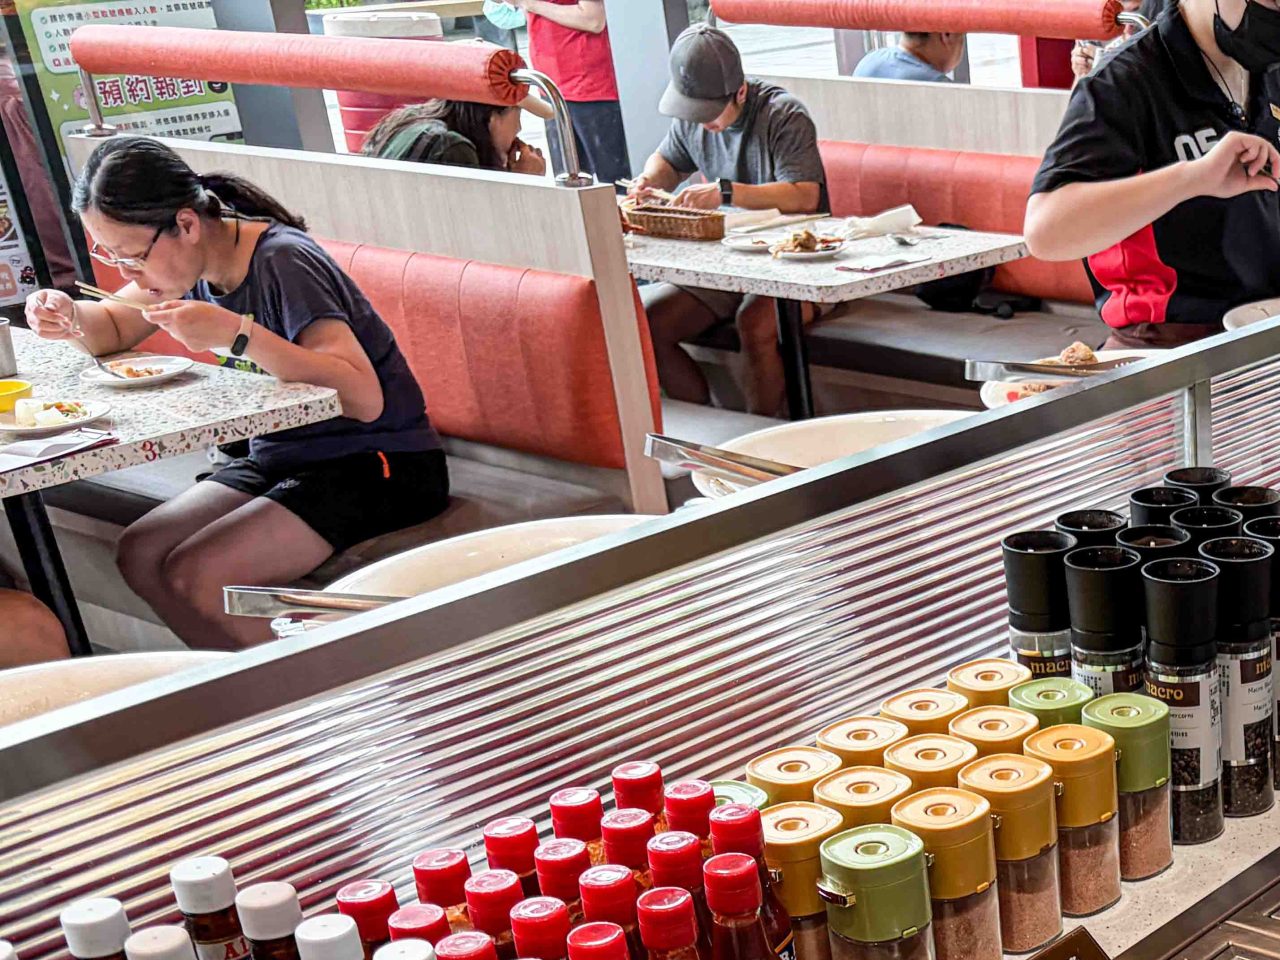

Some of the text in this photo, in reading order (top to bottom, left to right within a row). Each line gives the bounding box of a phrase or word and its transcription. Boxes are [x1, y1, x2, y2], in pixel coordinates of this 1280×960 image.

[96, 75, 205, 107] 預約報到
[142, 440, 157, 462] 3
[1030, 659, 1071, 674] macr
